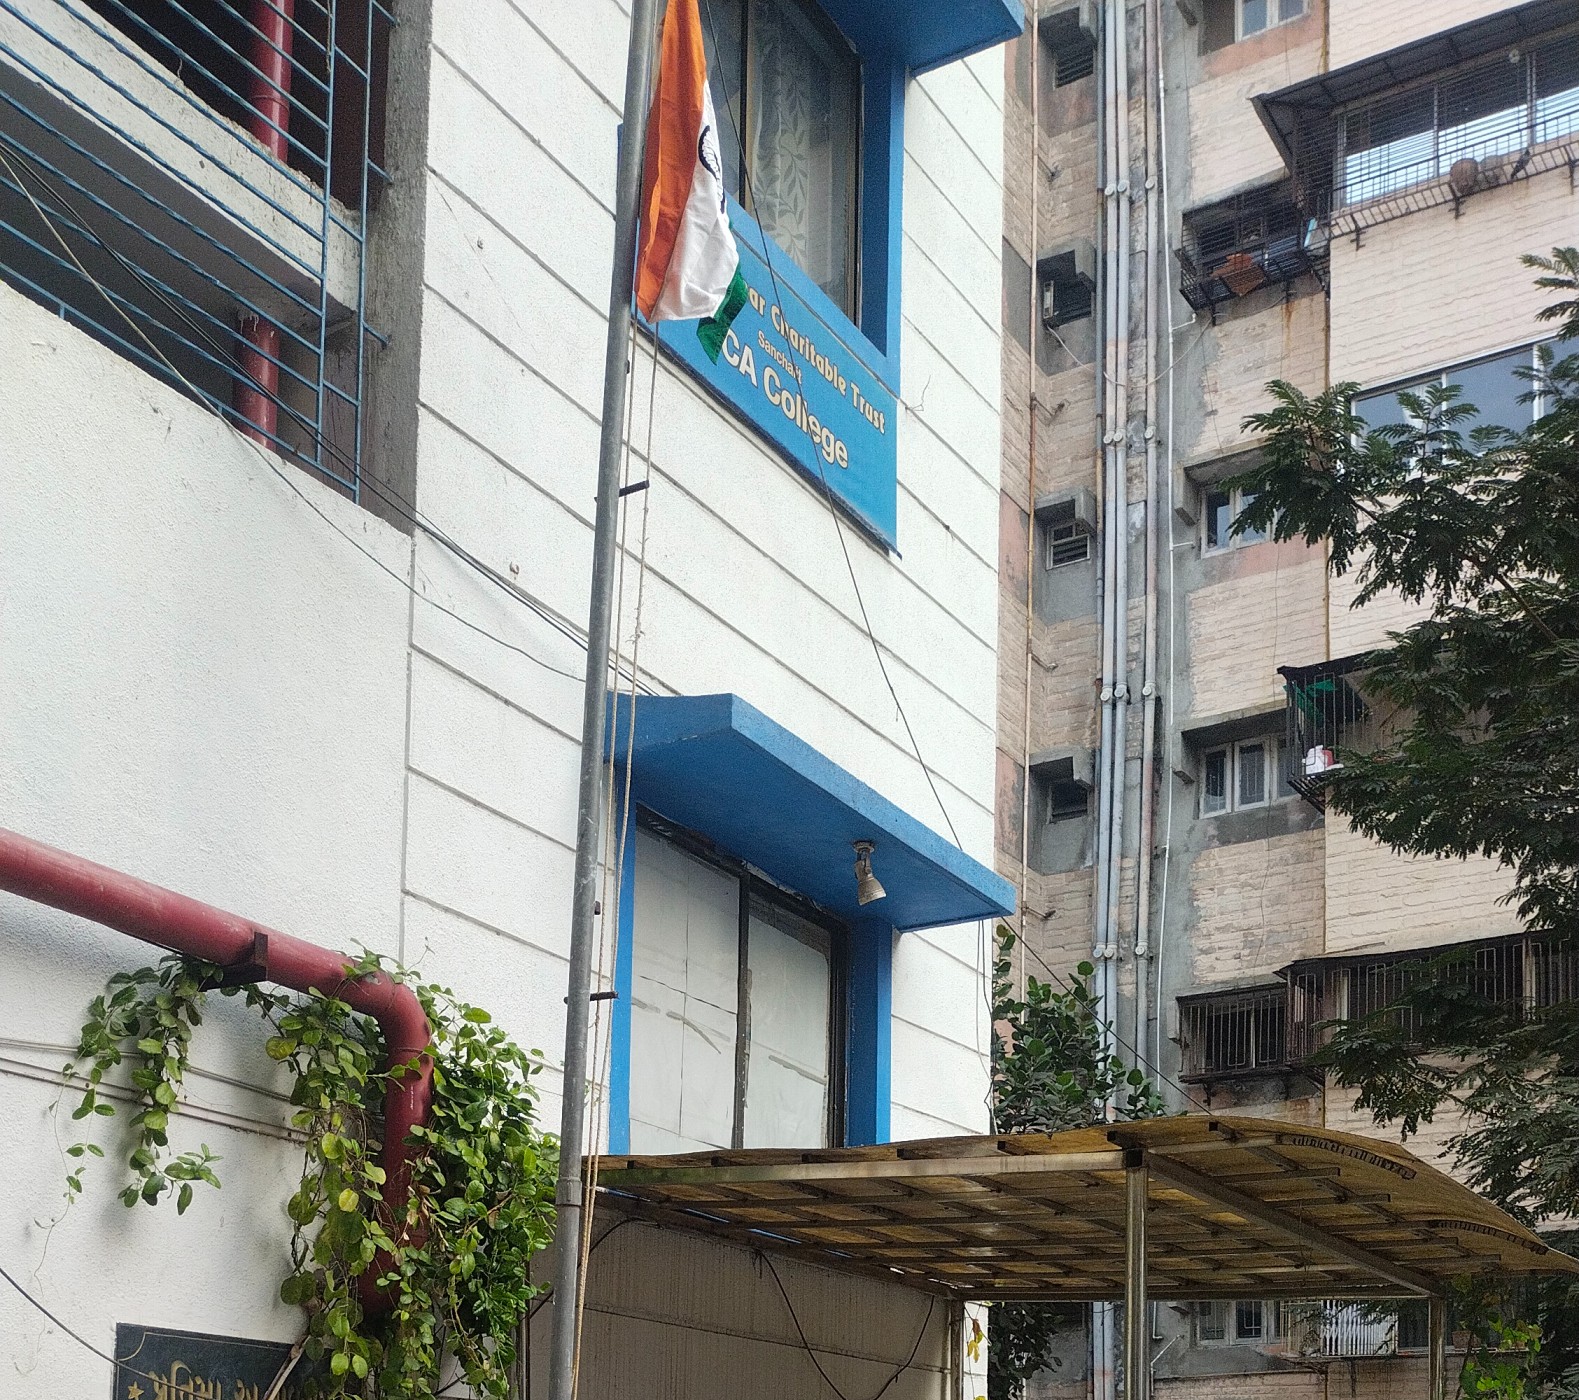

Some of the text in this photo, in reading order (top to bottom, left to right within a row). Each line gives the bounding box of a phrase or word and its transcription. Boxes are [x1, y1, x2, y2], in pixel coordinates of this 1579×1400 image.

[747, 286, 886, 435] ar Charitable Trust
[762, 366, 849, 470] College
